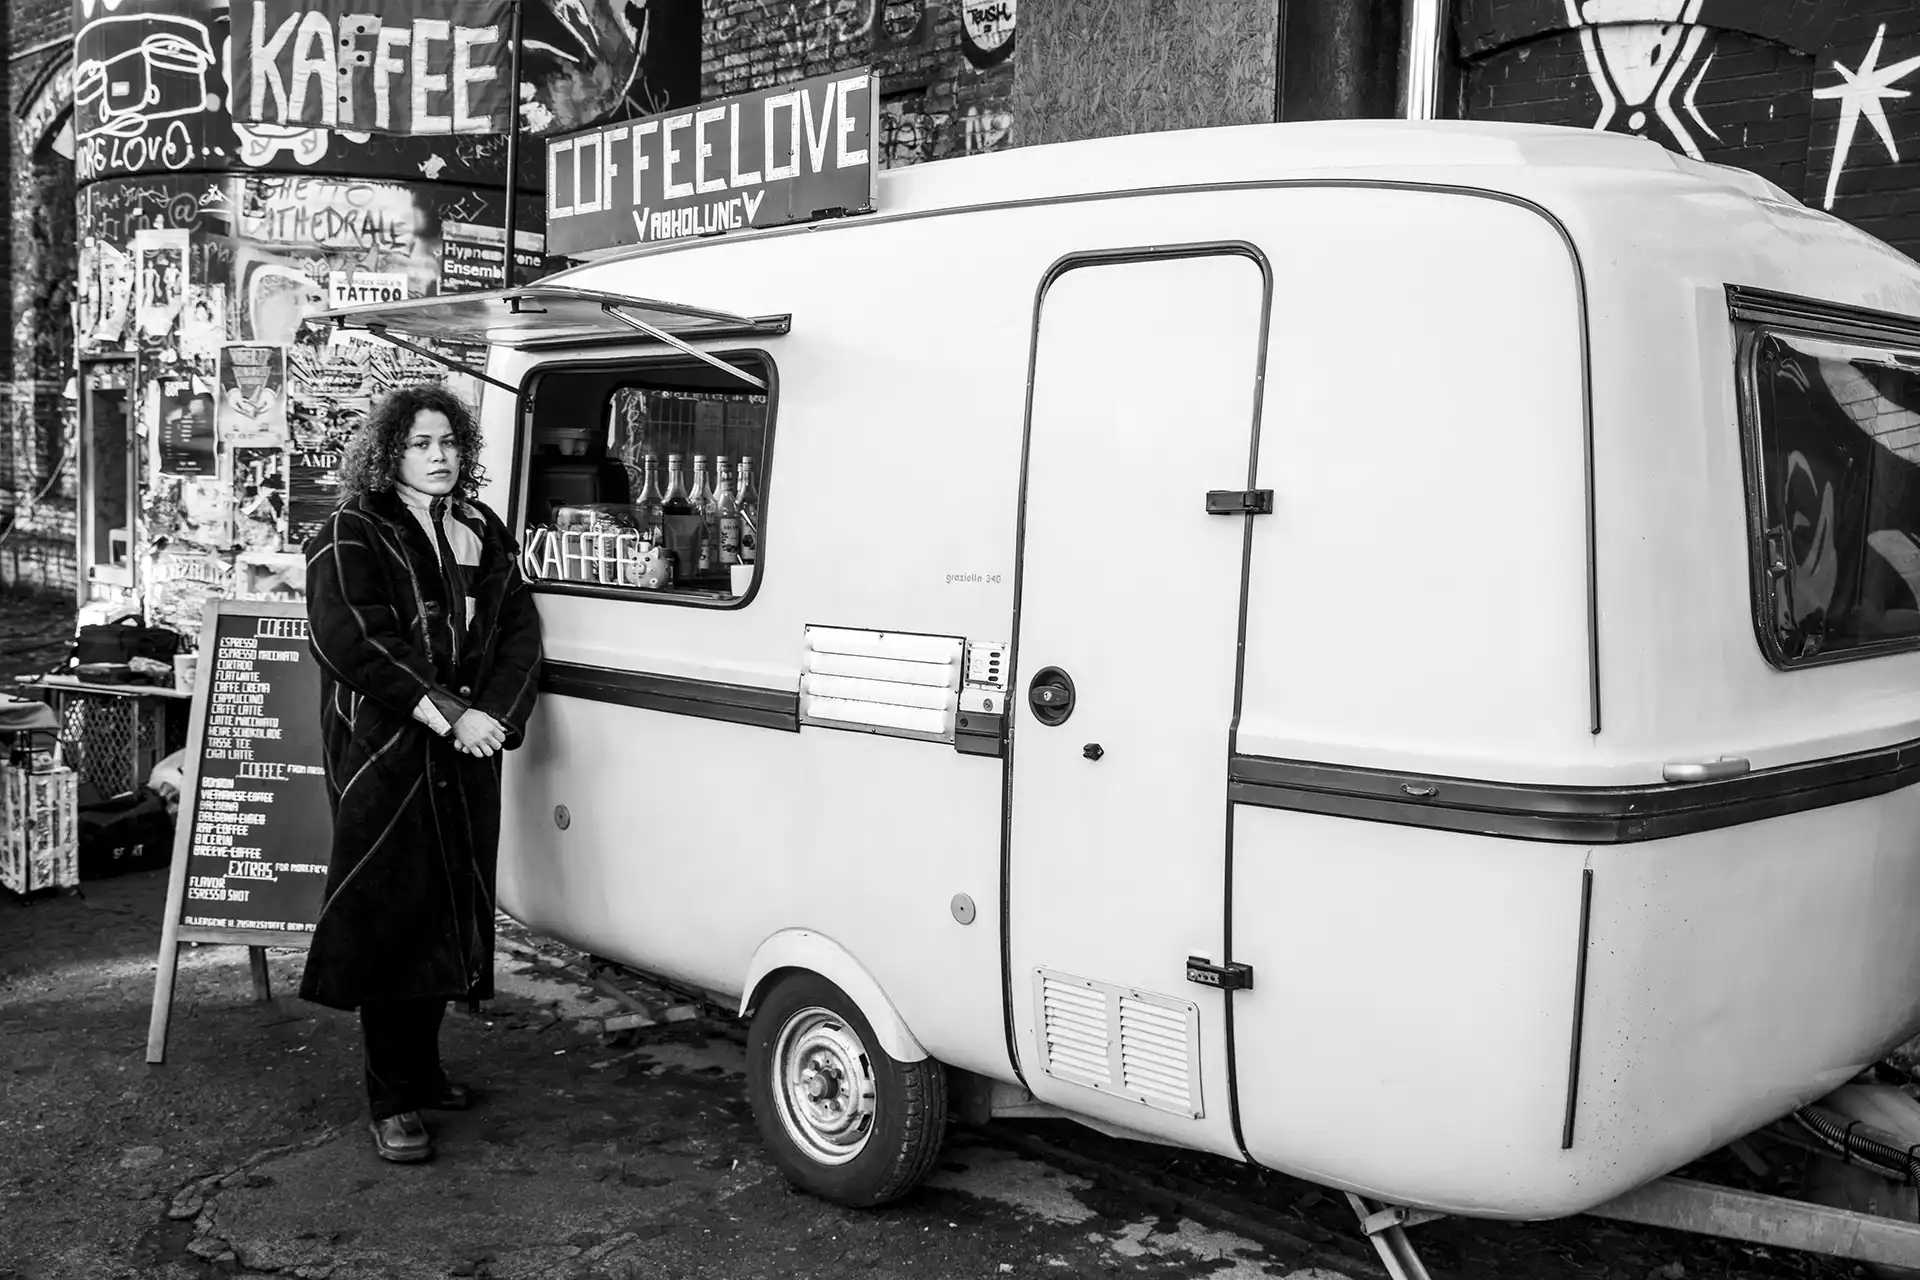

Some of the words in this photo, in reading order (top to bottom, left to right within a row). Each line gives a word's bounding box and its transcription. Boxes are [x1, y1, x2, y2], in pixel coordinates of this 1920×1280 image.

[250, 0, 499, 134] KAFFEE
[549, 74, 869, 219] COFFEELOVE
[336, 286, 402, 302] TATTOO
[525, 528, 638, 587] KAFFEE
[985, 574, 1001, 584] 340
[257, 618, 309, 639] COFFEE
[220, 637, 258, 648] ESPRESSO
[218, 648, 257, 660] ESPRESSO
[237, 705, 264, 716] LATTE
[209, 715, 234, 726] LATTE
[207, 737, 233, 748] TASSE
[235, 738, 252, 749] TEE
[228, 749, 255, 761] LATTE
[239, 761, 287, 780] COFFEE
[228, 860, 273, 878] EXTRAS
[189, 876, 226, 888] FLAVOR
[227, 889, 250, 902] SHOT
